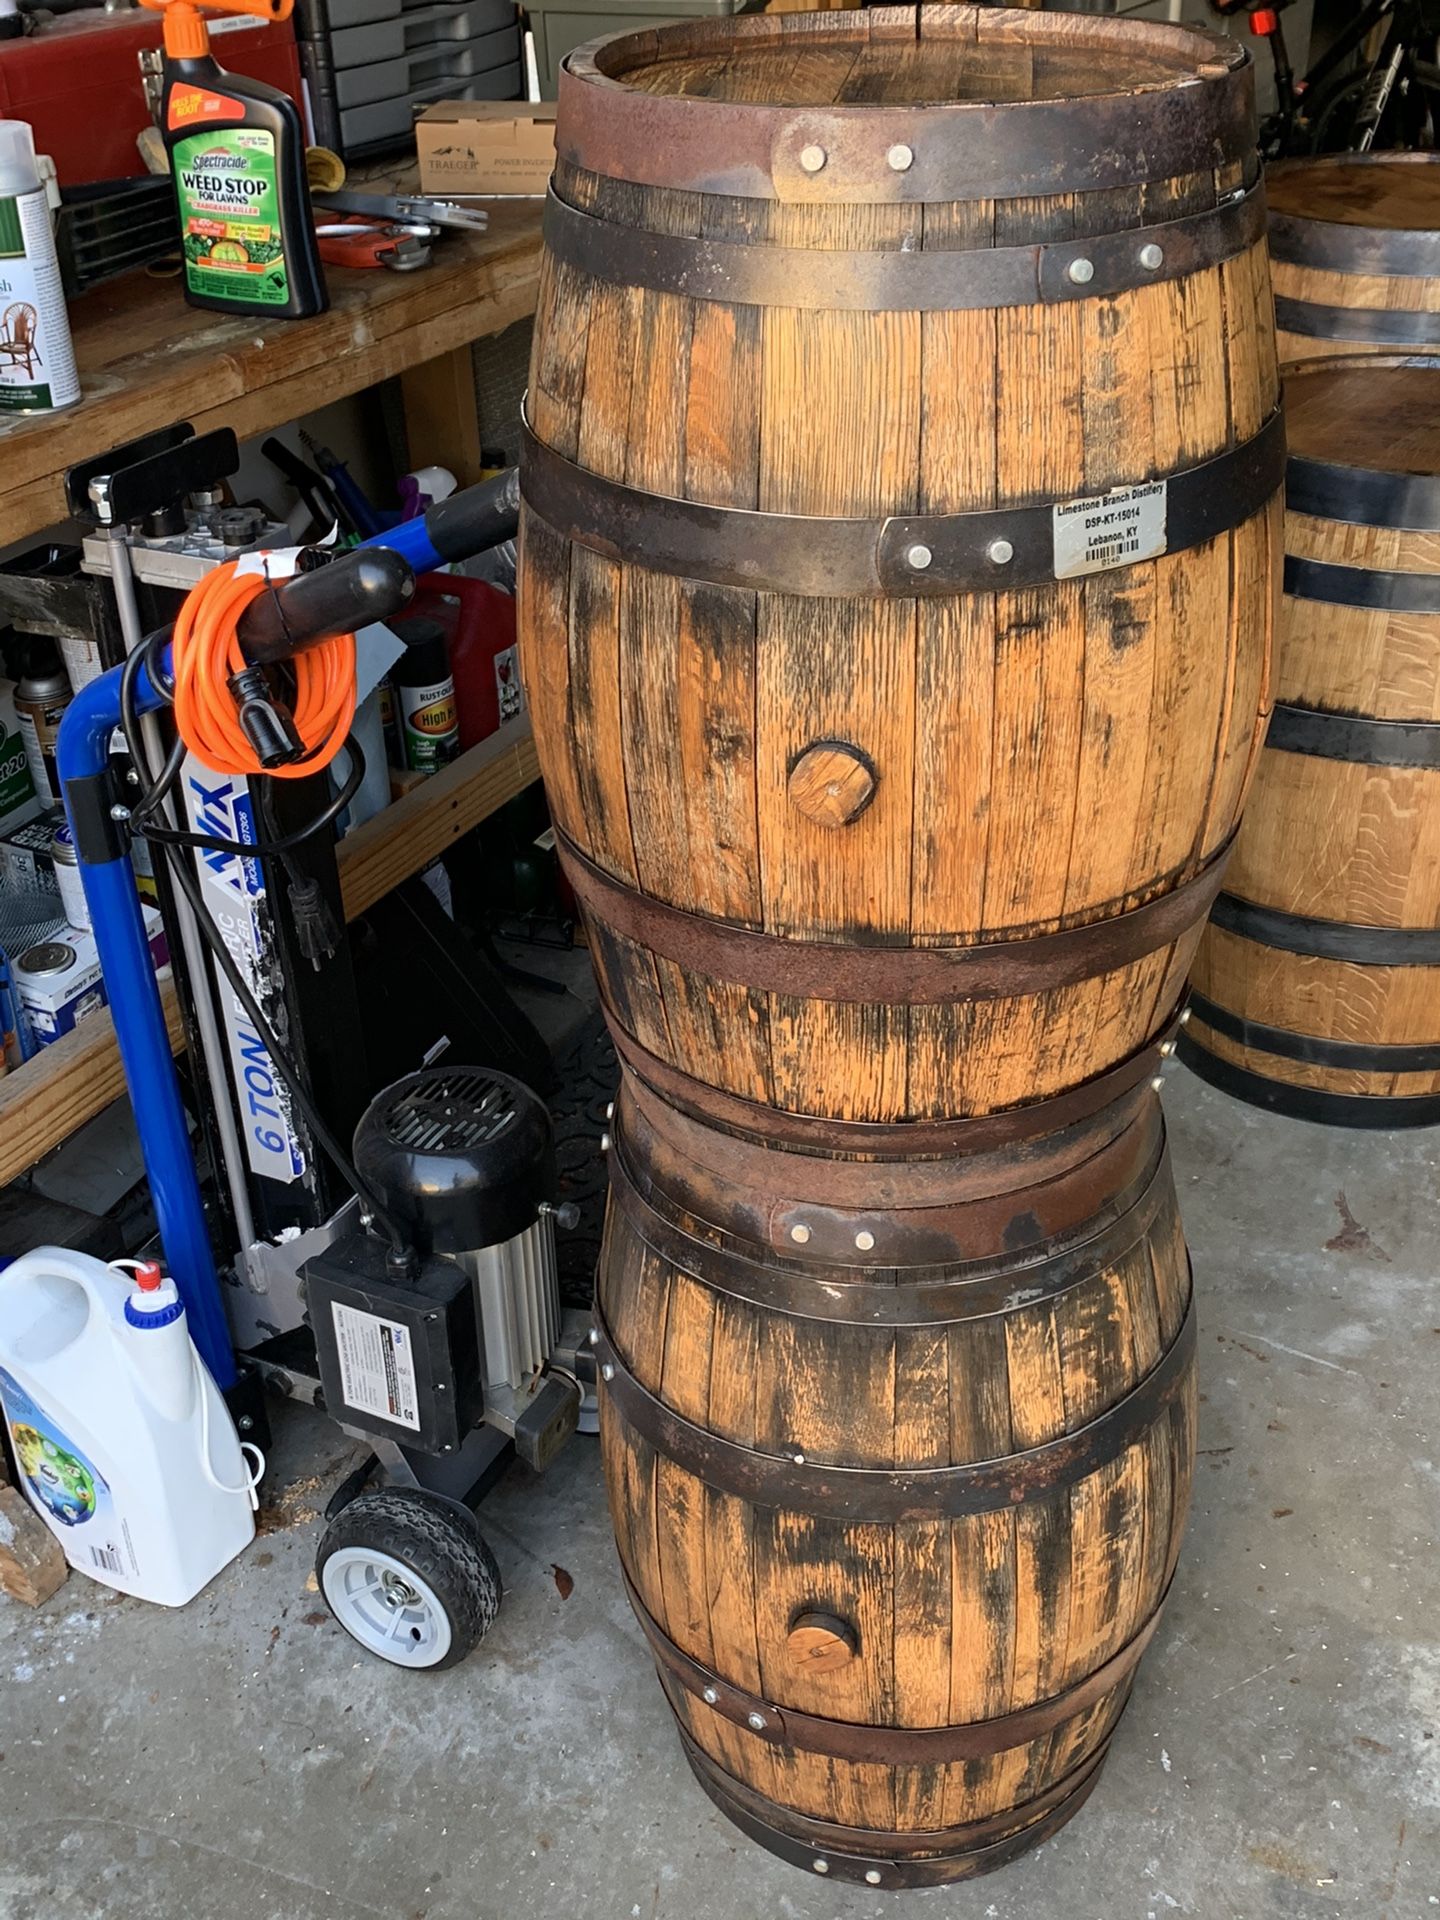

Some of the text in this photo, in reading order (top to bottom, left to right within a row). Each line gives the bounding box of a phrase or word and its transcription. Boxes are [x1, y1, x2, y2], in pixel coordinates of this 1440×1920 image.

[193, 155, 247, 172] Spectracide
[429, 160, 477, 169] TRAEGER
[182, 172, 267, 195] WEED STOP
[199, 191, 248, 205] FOR LAWNS
[1057, 483, 1165, 517] Limestone Branch Distillery
[1085, 507, 1141, 529] DSP-KT-15014
[1088, 526, 1138, 547] Lebanon, KY
[422, 710, 447, 727] High
[9, 751, 26, 777] 20
[237, 1031, 280, 1120] TON
[254, 1126, 285, 1154] 6
